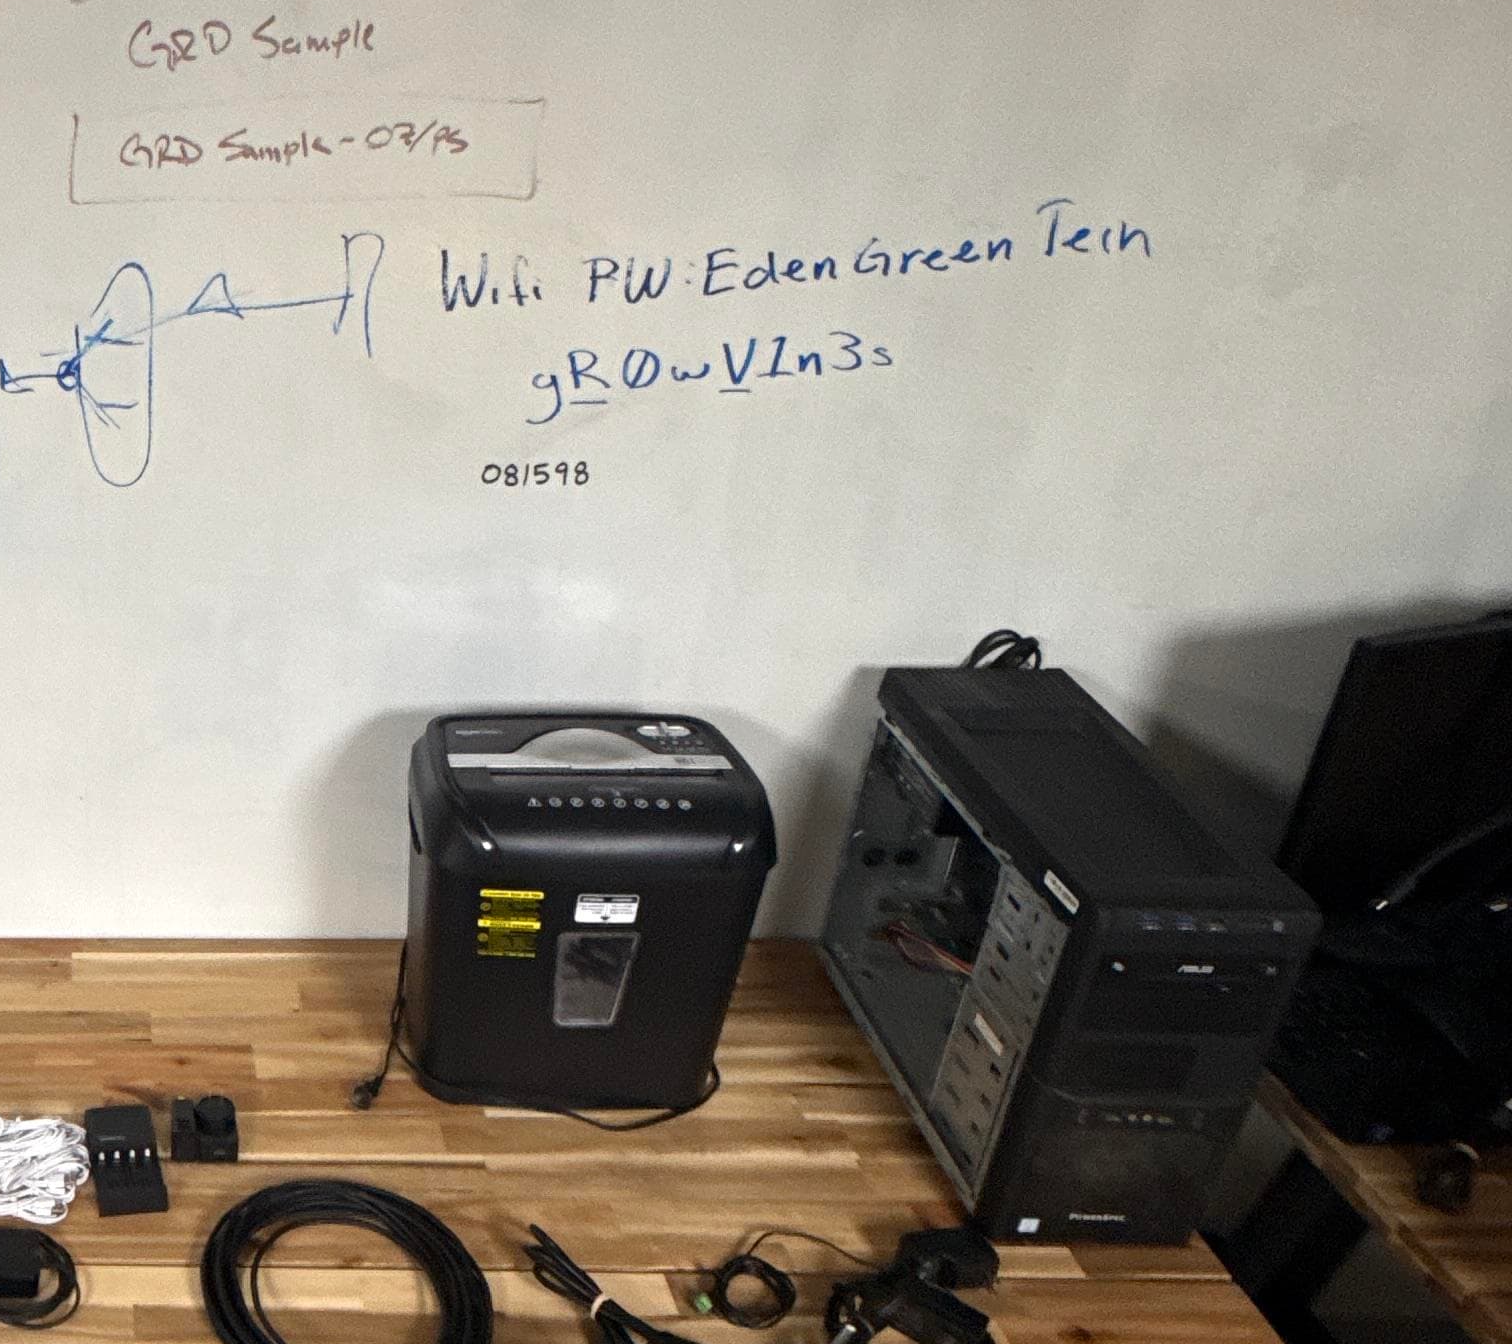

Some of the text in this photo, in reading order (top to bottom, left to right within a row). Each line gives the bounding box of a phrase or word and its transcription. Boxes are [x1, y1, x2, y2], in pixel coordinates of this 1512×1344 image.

[252, 14, 376, 59] Sample
[218, 128, 333, 166] Sample
[479, 461, 591, 488] 081598
